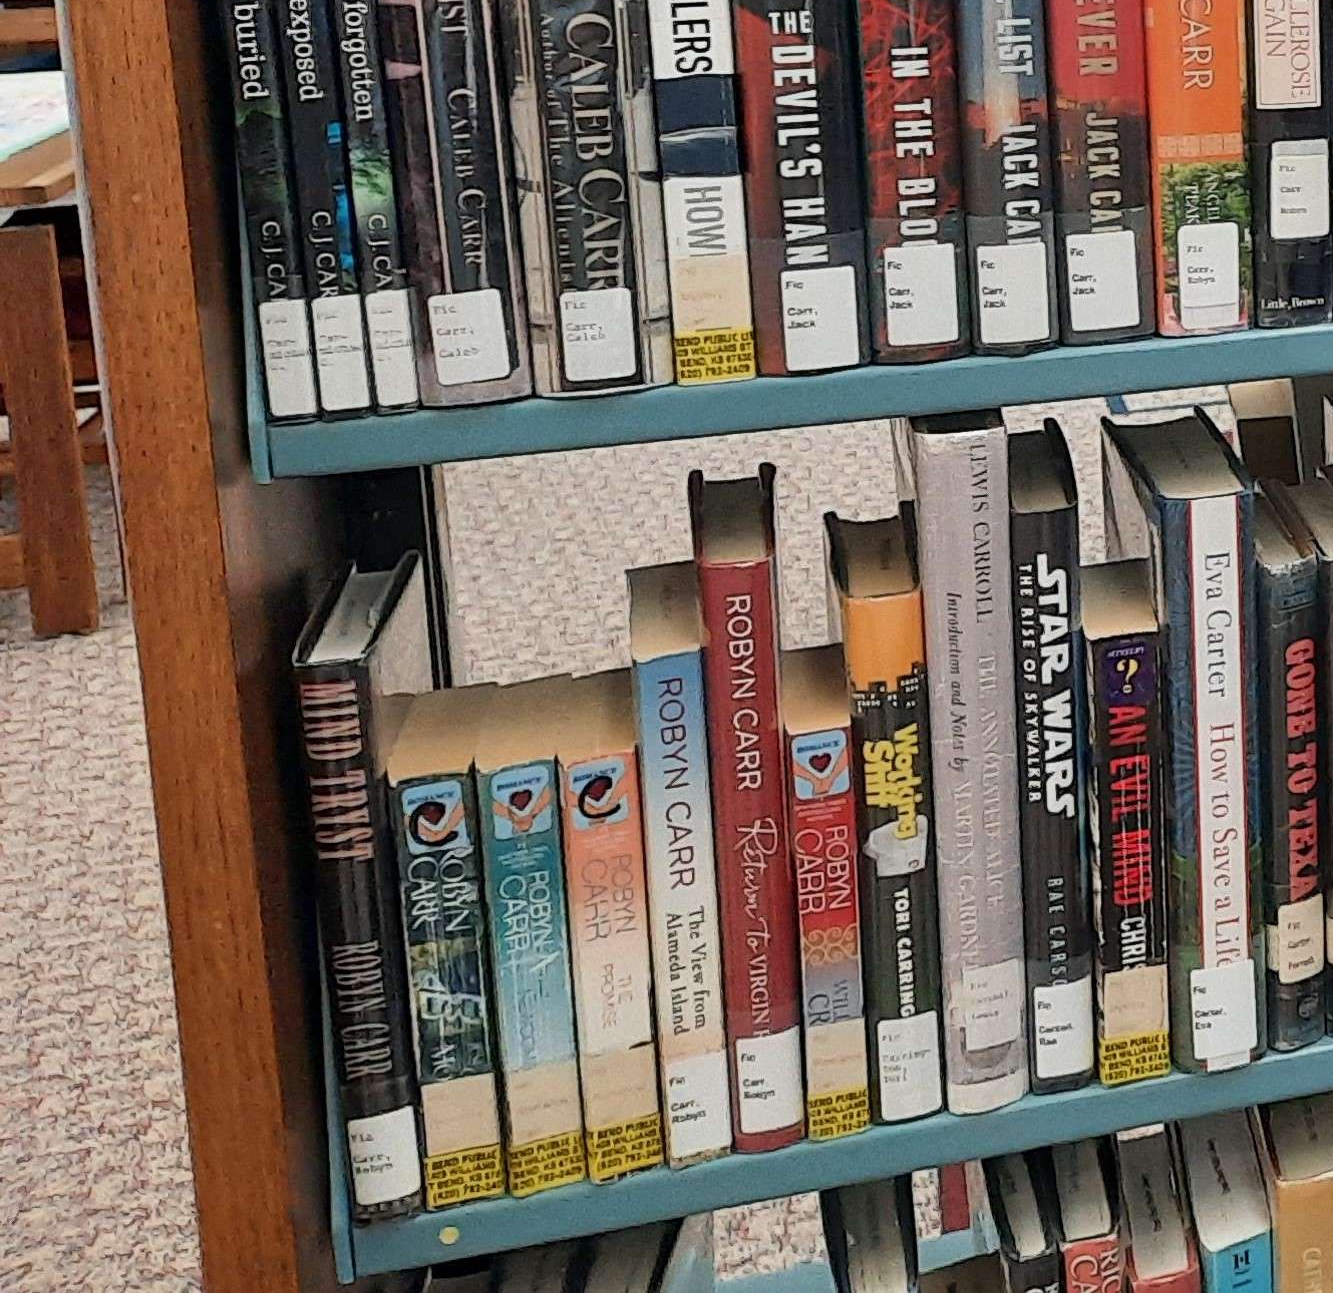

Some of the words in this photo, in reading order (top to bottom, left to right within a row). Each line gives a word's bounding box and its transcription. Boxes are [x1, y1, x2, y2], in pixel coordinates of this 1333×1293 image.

[234, 3, 270, 100] buried
[340, 1, 374, 122] forgotten
[768, 10, 815, 36] THE
[890, 45, 931, 81] IN
[994, 13, 1037, 79] LIST
[563, 11, 616, 162] CALEB
[768, 42, 824, 179] DEVIL'S
[445, 87, 475, 195] CALEB
[891, 97, 934, 161] THE
[1001, 122, 1041, 190] JACK
[1085, 110, 1121, 188] JACK
[456, 187, 488, 267] CARR
[577, 167, 627, 290] CARR
[1016, 563, 1035, 601] THE
[1201, 549, 1233, 604] Eva
[724, 593, 756, 700] ROBYN
[1017, 604, 1036, 650] RISE
[1034, 552, 1070, 687] STAR
[1203, 606, 1235, 701] Carter
[1282, 637, 1319, 736] GONE
[656, 676, 692, 791] ROBYN
[731, 705, 764, 793] CARR
[1022, 690, 1044, 804] SKYWALKER
[1041, 688, 1077, 821] WARS
[1208, 721, 1237, 786] How
[1107, 754, 1154, 824] EVIL
[664, 800, 698, 891] CARR
[793, 829, 827, 916] CARR
[823, 824, 857, 910] ROBYN
[1211, 826, 1240, 892] Save
[665, 912, 684, 977] Alameda
[688, 904, 706, 940] The
[893, 887, 912, 933] TORI
[689, 941, 709, 984] View
[671, 978, 692, 1037] Island
